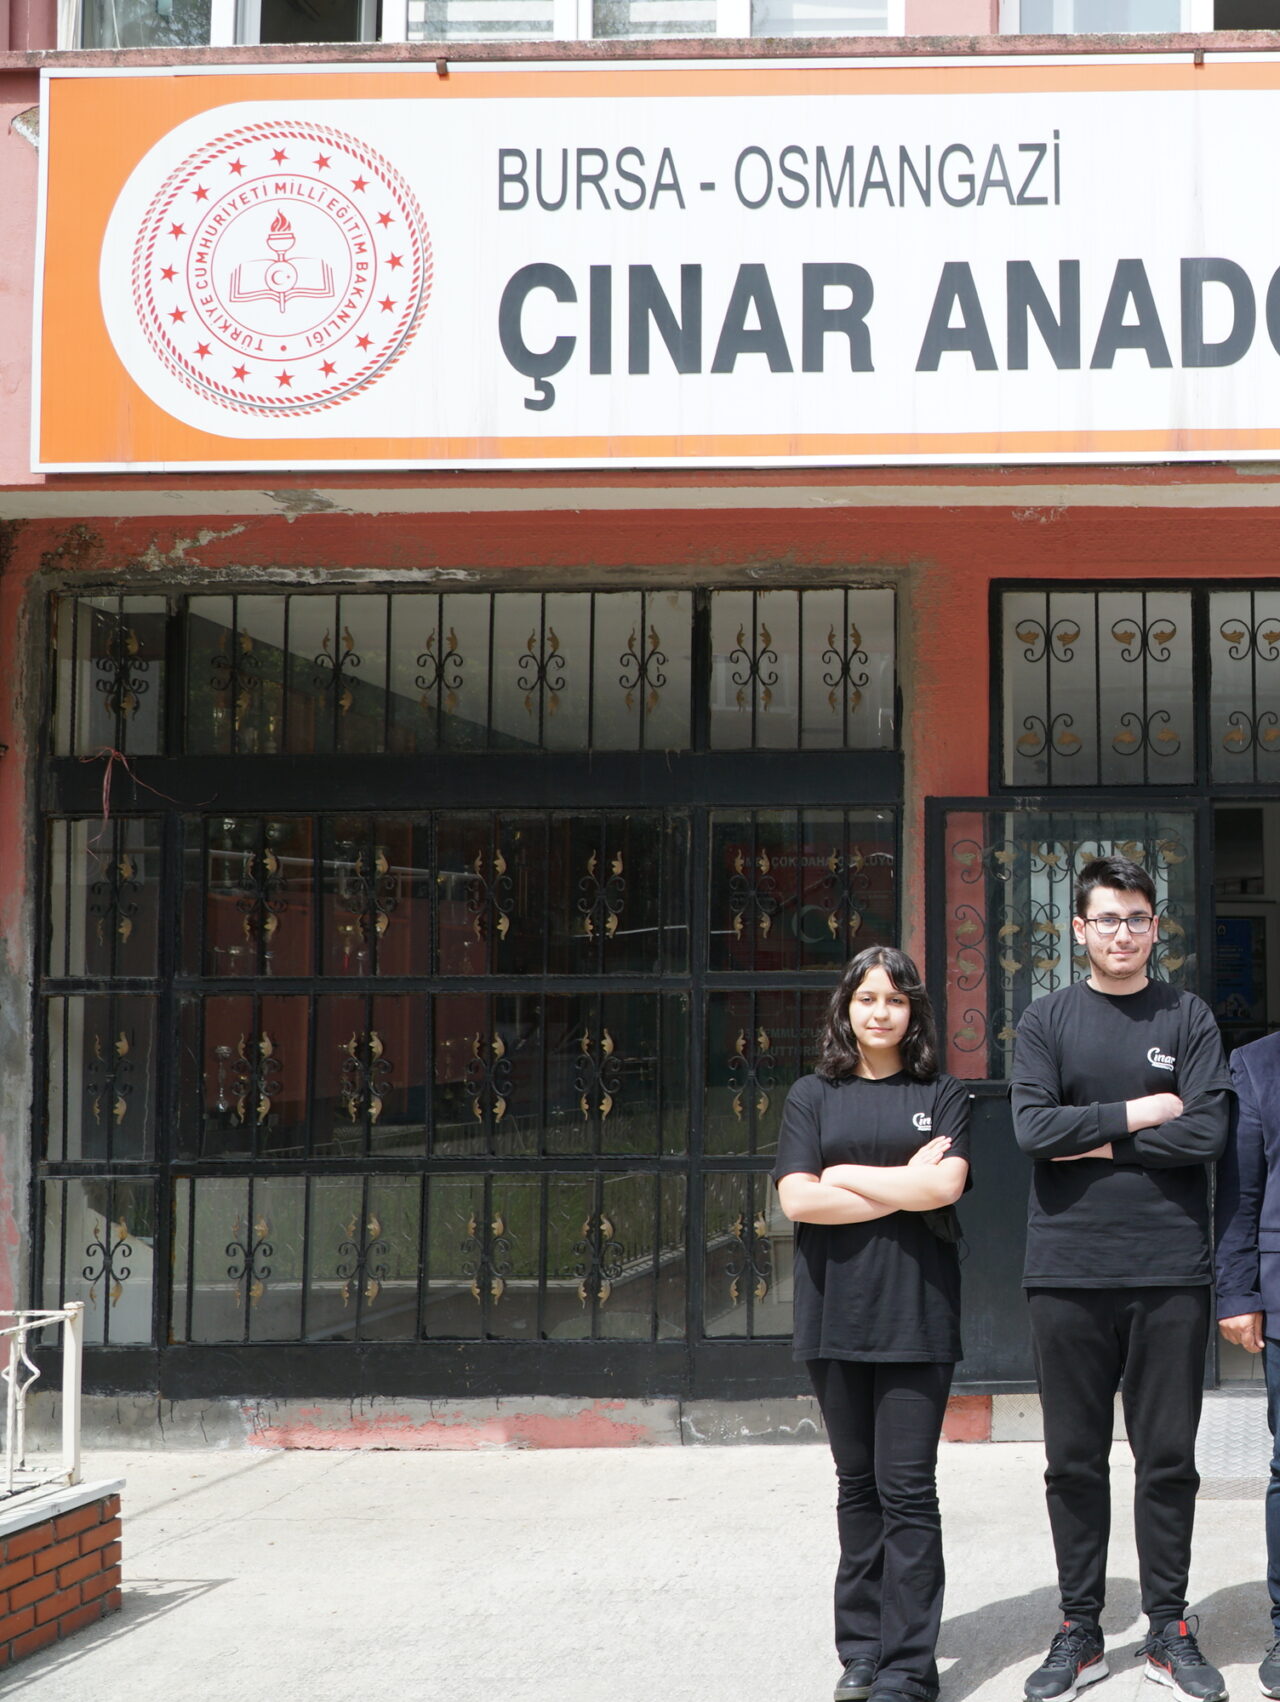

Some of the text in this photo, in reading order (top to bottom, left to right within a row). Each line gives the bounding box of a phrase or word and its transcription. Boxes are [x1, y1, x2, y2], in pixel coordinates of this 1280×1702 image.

[498, 146, 686, 211] BURSA
[734, 129, 1061, 209] OSMANGAZİ
[194, 181, 268, 290] CUMHURİYETİ
[200, 294, 263, 352] TÜRKİYE
[498, 262, 875, 411] ÇINAR
